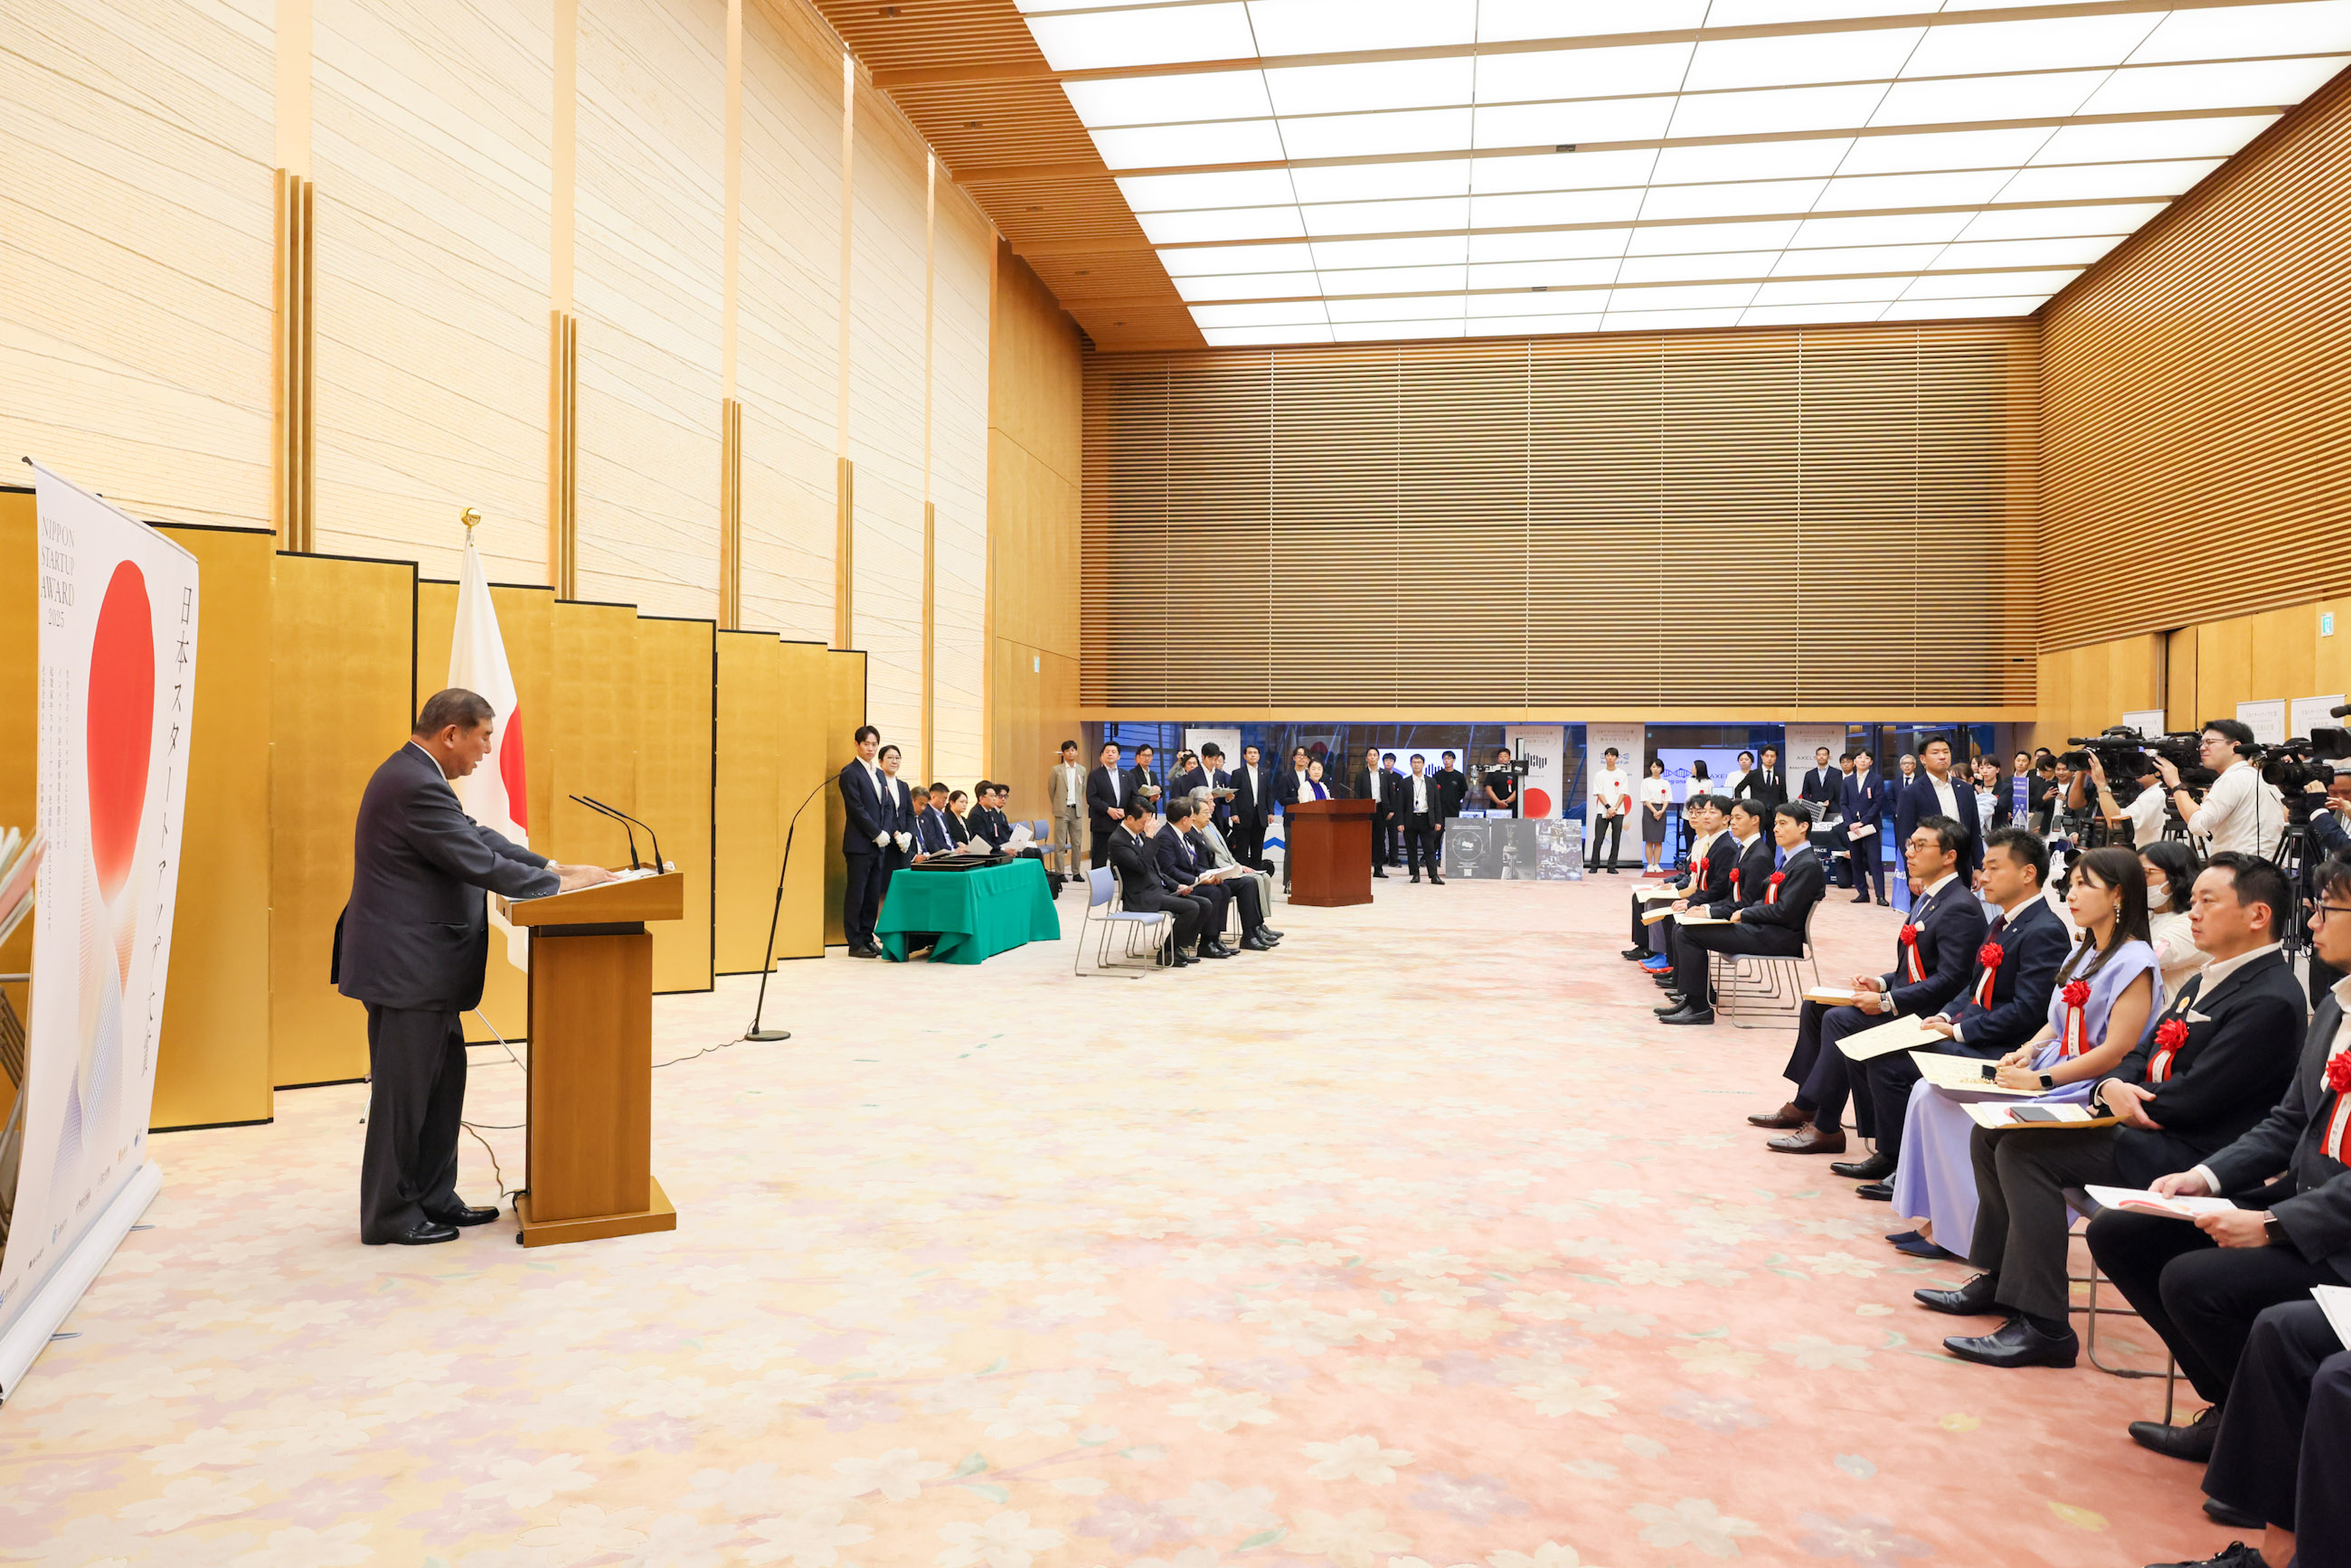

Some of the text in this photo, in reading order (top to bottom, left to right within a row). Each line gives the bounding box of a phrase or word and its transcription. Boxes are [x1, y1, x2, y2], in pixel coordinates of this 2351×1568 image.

[42, 515, 74, 548] NIPPON
[41, 545, 74, 576] STARTUP
[40, 575, 74, 607] AWARD
[48, 608, 64, 628] 2025
